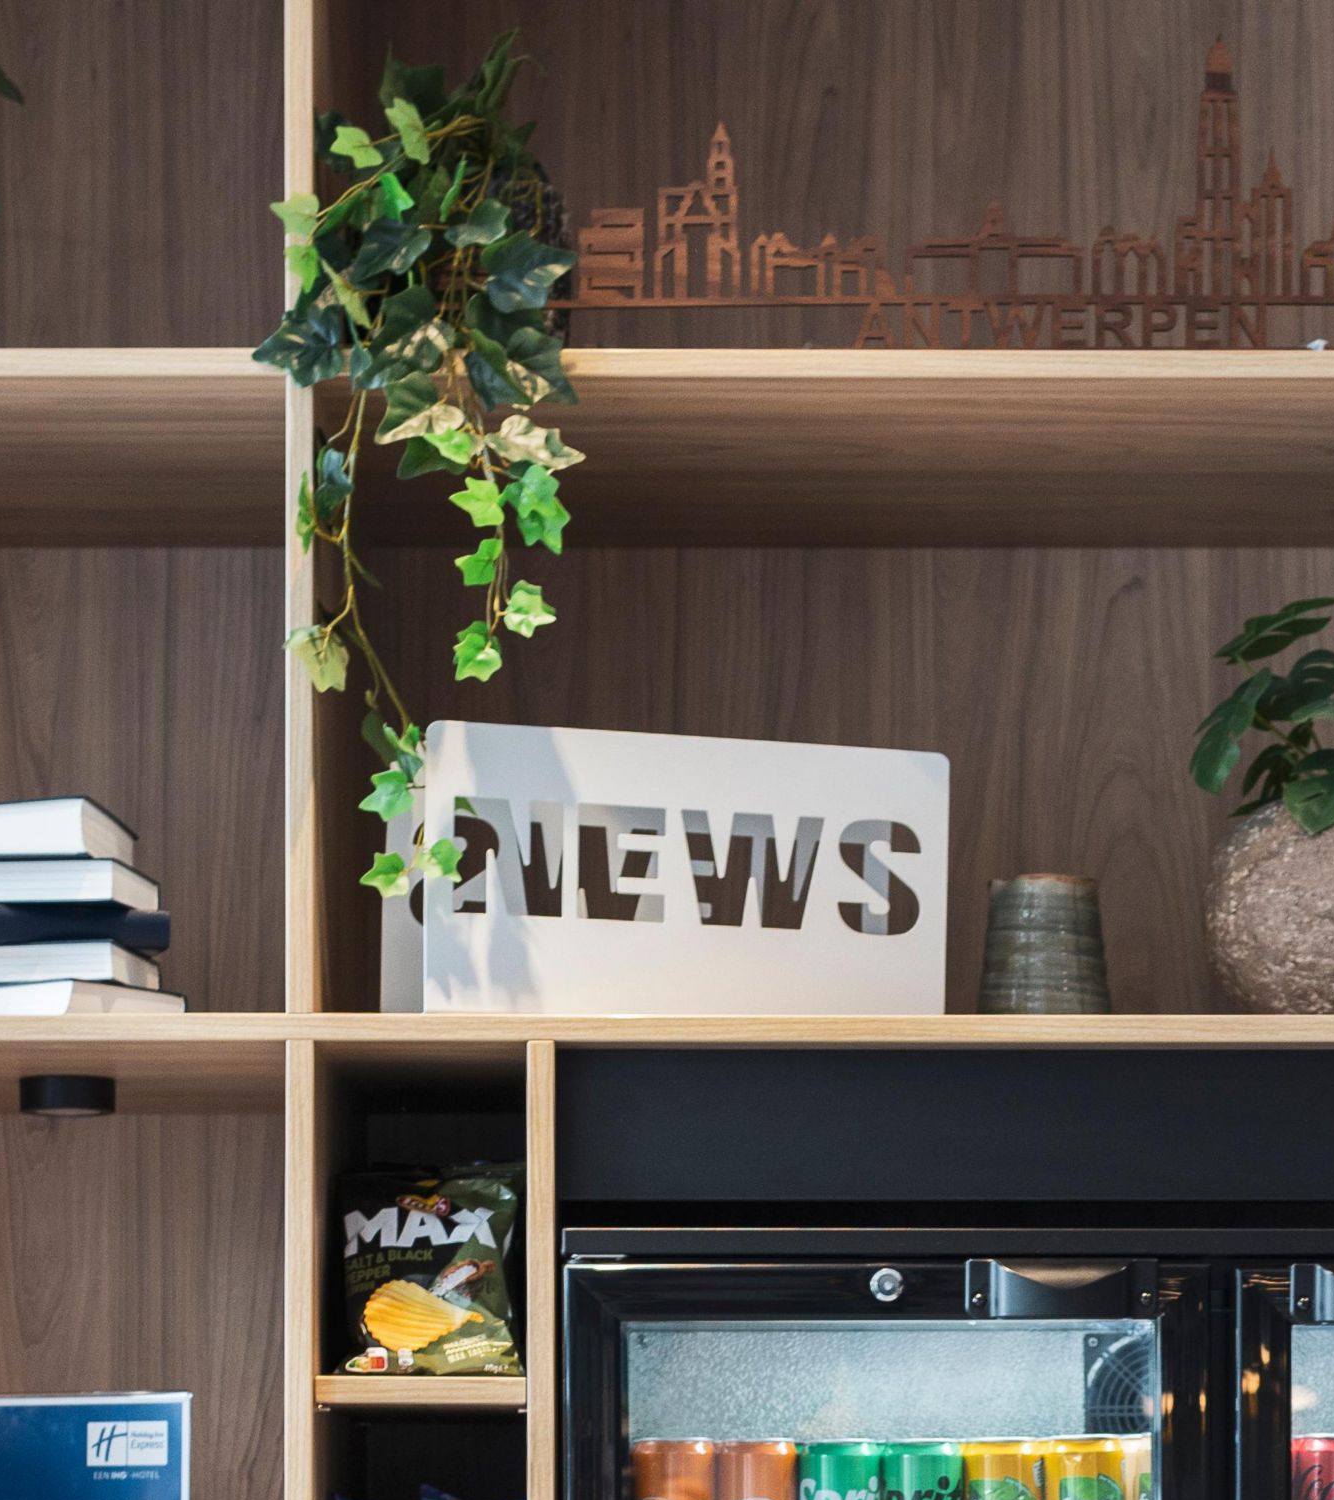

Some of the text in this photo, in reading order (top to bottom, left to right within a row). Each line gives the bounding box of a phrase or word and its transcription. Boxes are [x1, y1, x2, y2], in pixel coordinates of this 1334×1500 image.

[856, 302, 1264, 350] ANTWERPEN
[455, 796, 921, 936] NEWS
[344, 1207, 498, 1258] MAX
[350, 1264, 391, 1282] EPPER
